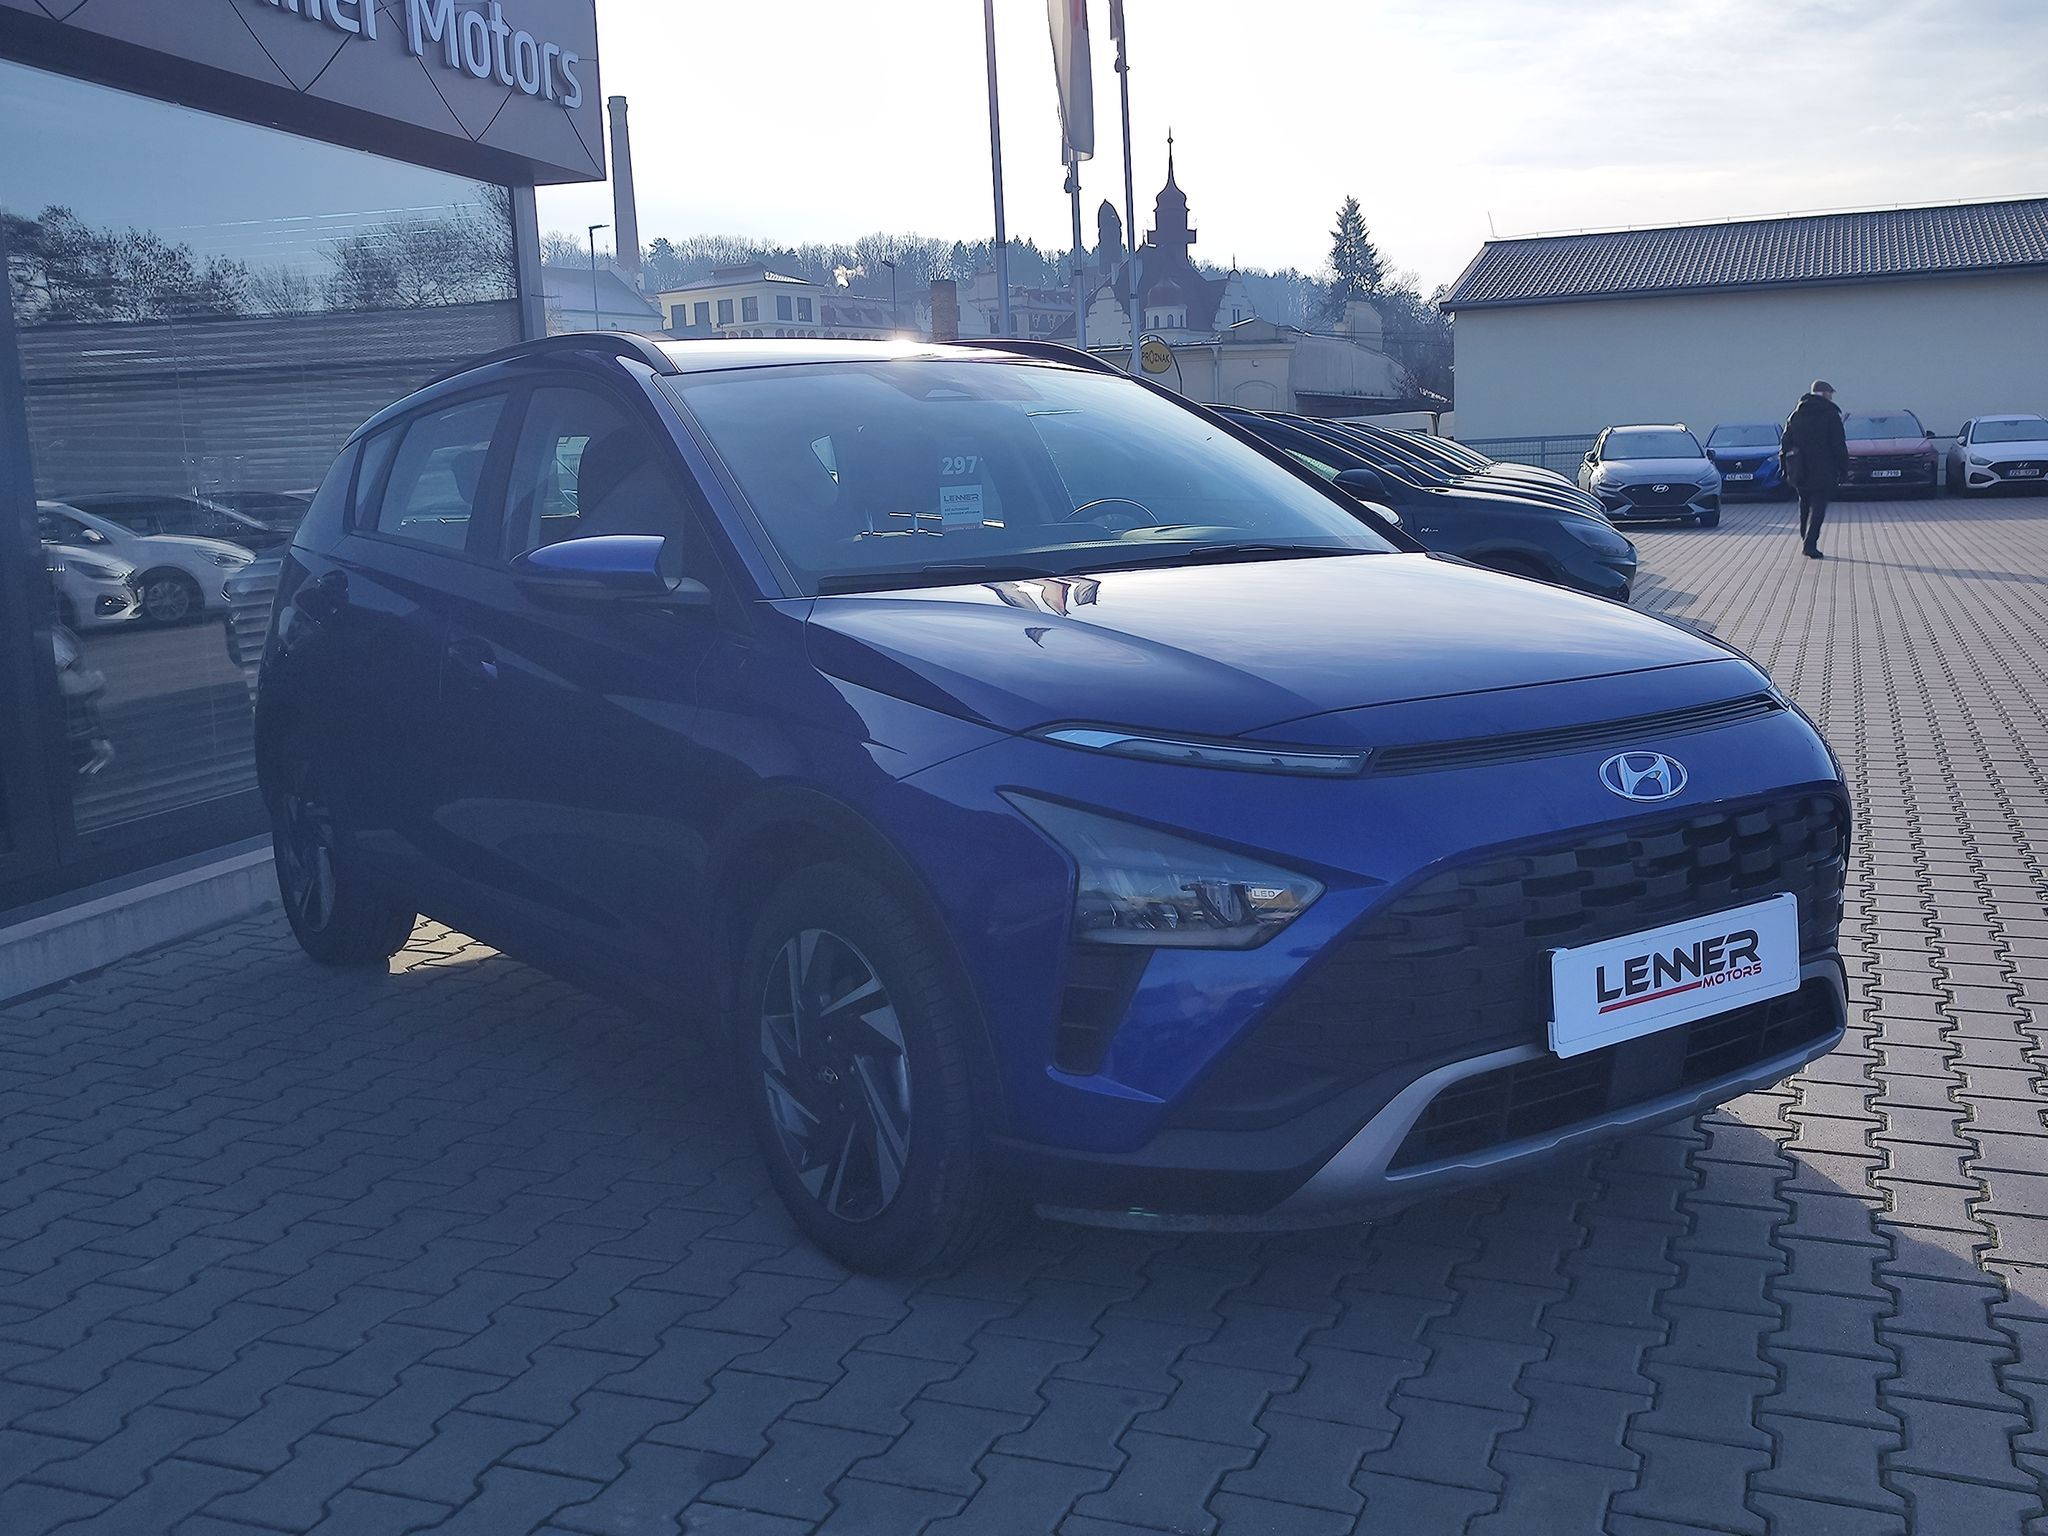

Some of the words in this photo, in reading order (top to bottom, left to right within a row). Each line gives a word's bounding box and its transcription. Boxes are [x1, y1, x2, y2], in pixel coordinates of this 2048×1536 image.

[406, 0, 584, 109] Motors
[942, 455, 977, 475] 297
[943, 493, 980, 502] LENNER
[1253, 889, 1276, 898] LED
[1596, 929, 1762, 1004] LENNER
[1702, 962, 1762, 989] MOTORS
